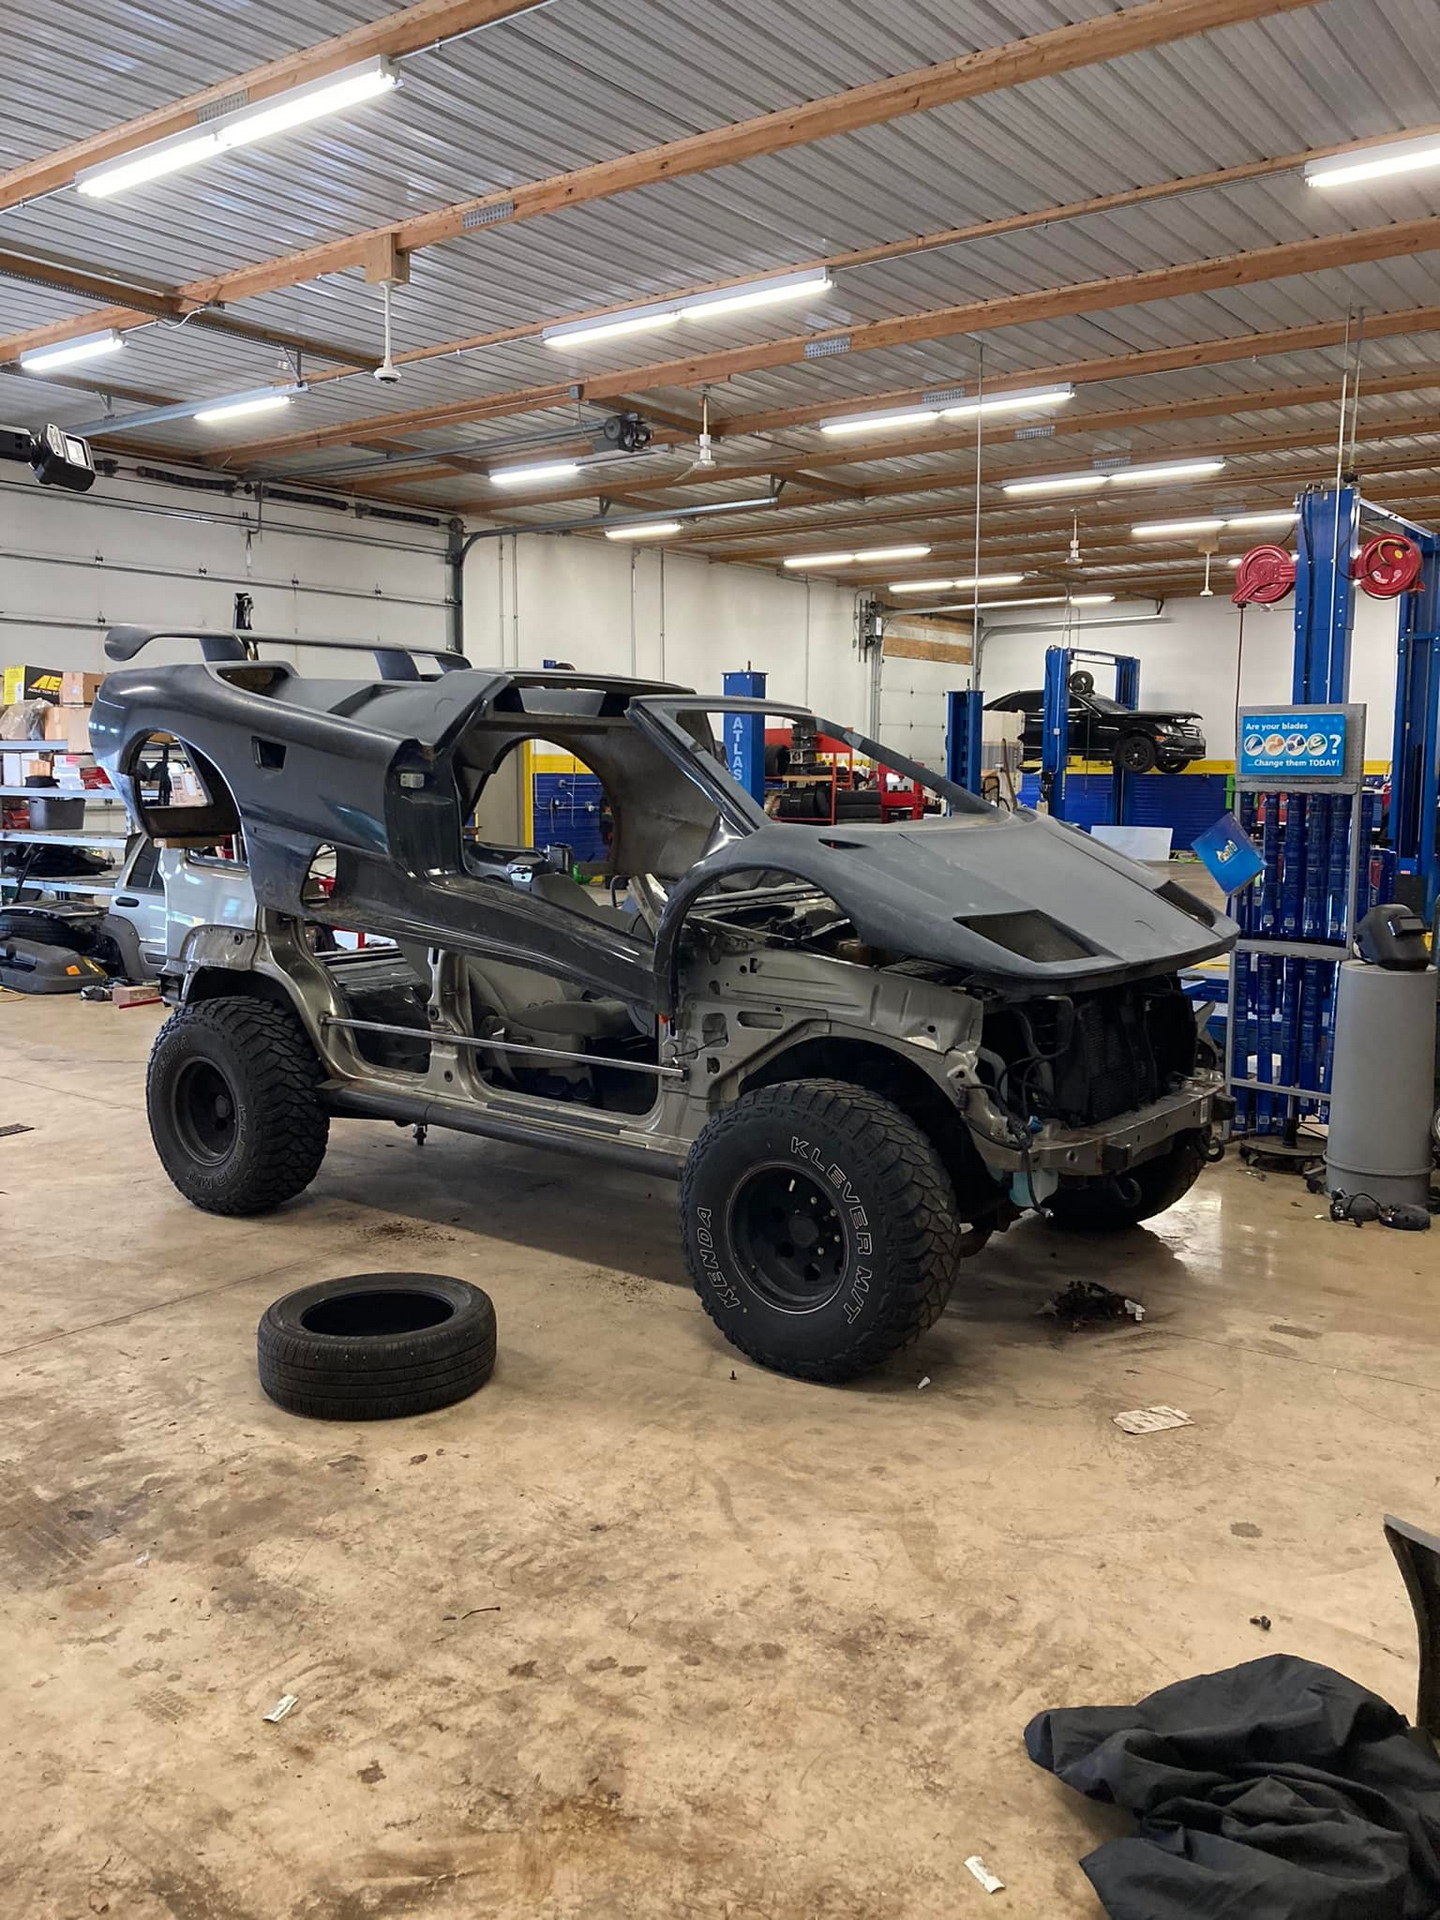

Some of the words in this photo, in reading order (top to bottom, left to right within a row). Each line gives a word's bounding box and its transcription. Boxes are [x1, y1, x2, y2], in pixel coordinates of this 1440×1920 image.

[733, 717, 743, 780] ATLAS
[1261, 724, 1280, 732] your
[1309, 759, 1339, 767] TODAY!
[697, 1206, 740, 1309] KENDA
[790, 1136, 873, 1256] KLEVER
[843, 1265, 873, 1324] M/T
